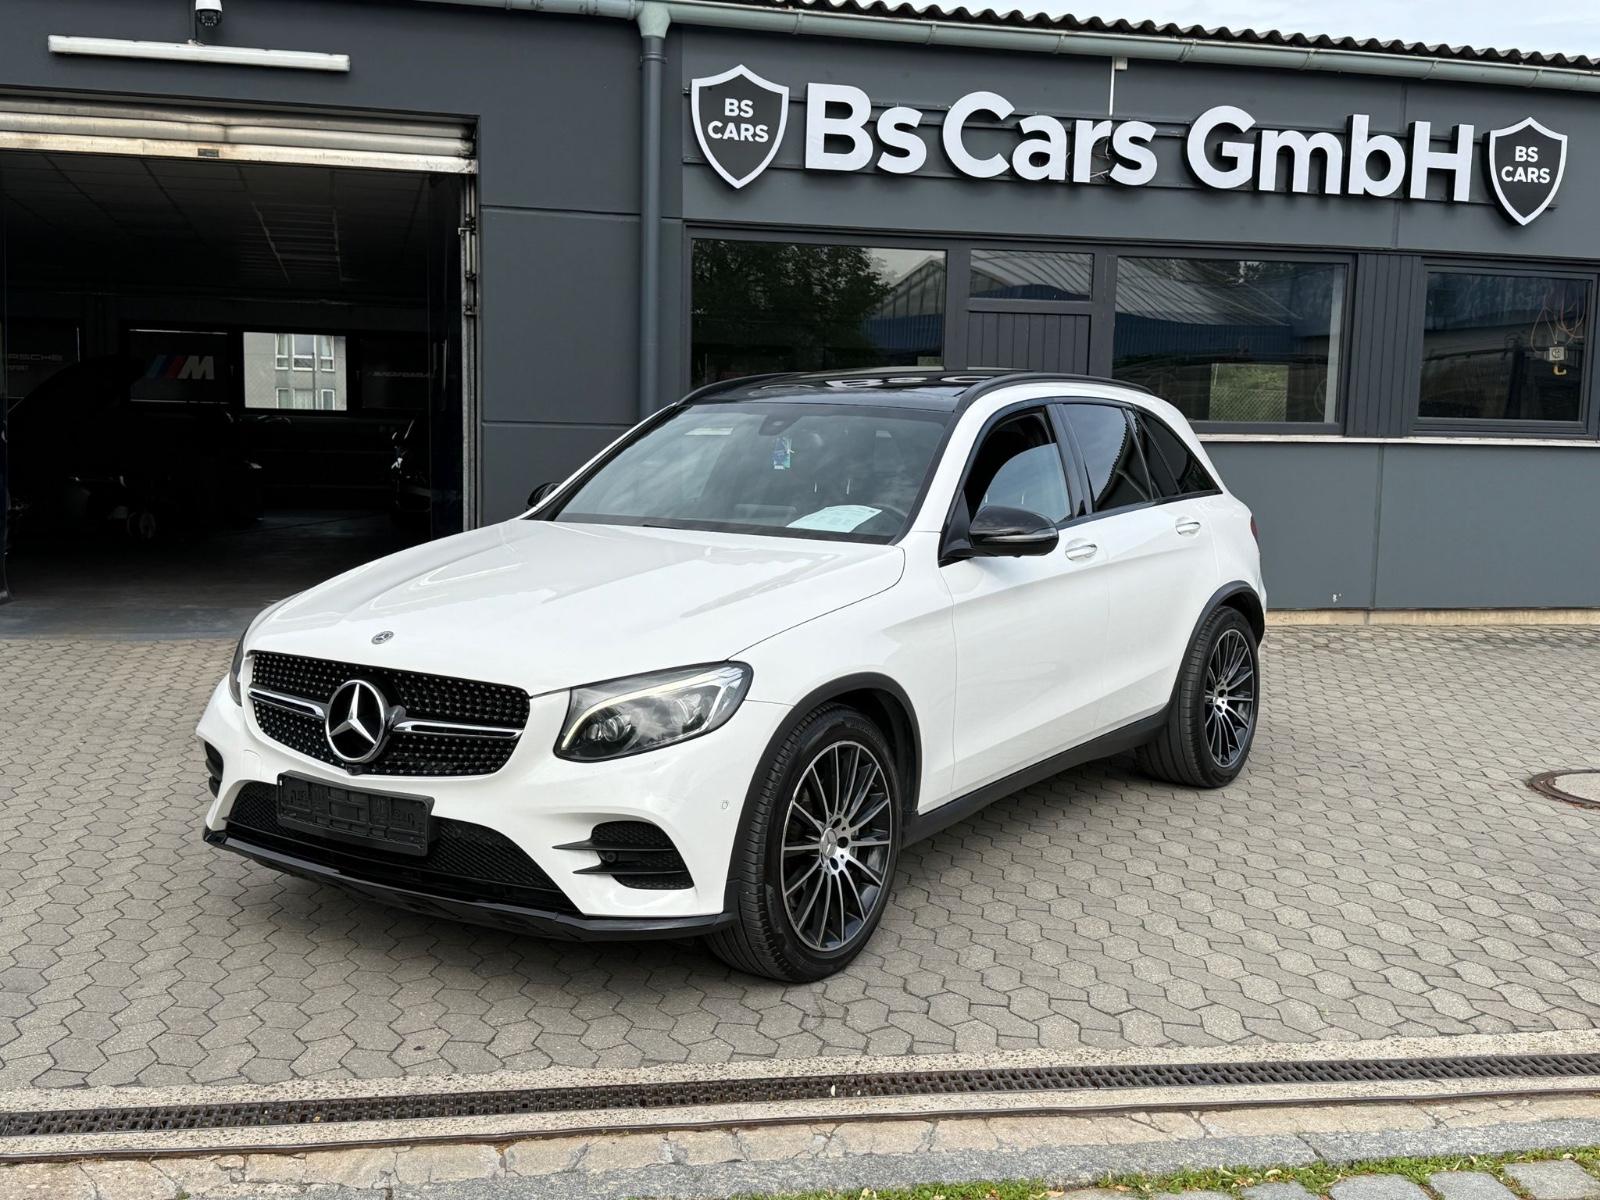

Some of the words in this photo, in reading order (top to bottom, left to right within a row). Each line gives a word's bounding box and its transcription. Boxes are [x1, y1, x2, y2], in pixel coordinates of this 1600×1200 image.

[724, 98, 754, 118] BS
[707, 120, 769, 143] CARS
[942, 91, 1158, 186] Cars
[1186, 105, 1475, 202] GmbH
[1515, 145, 1539, 162] BS
[1501, 165, 1551, 184] CARS
